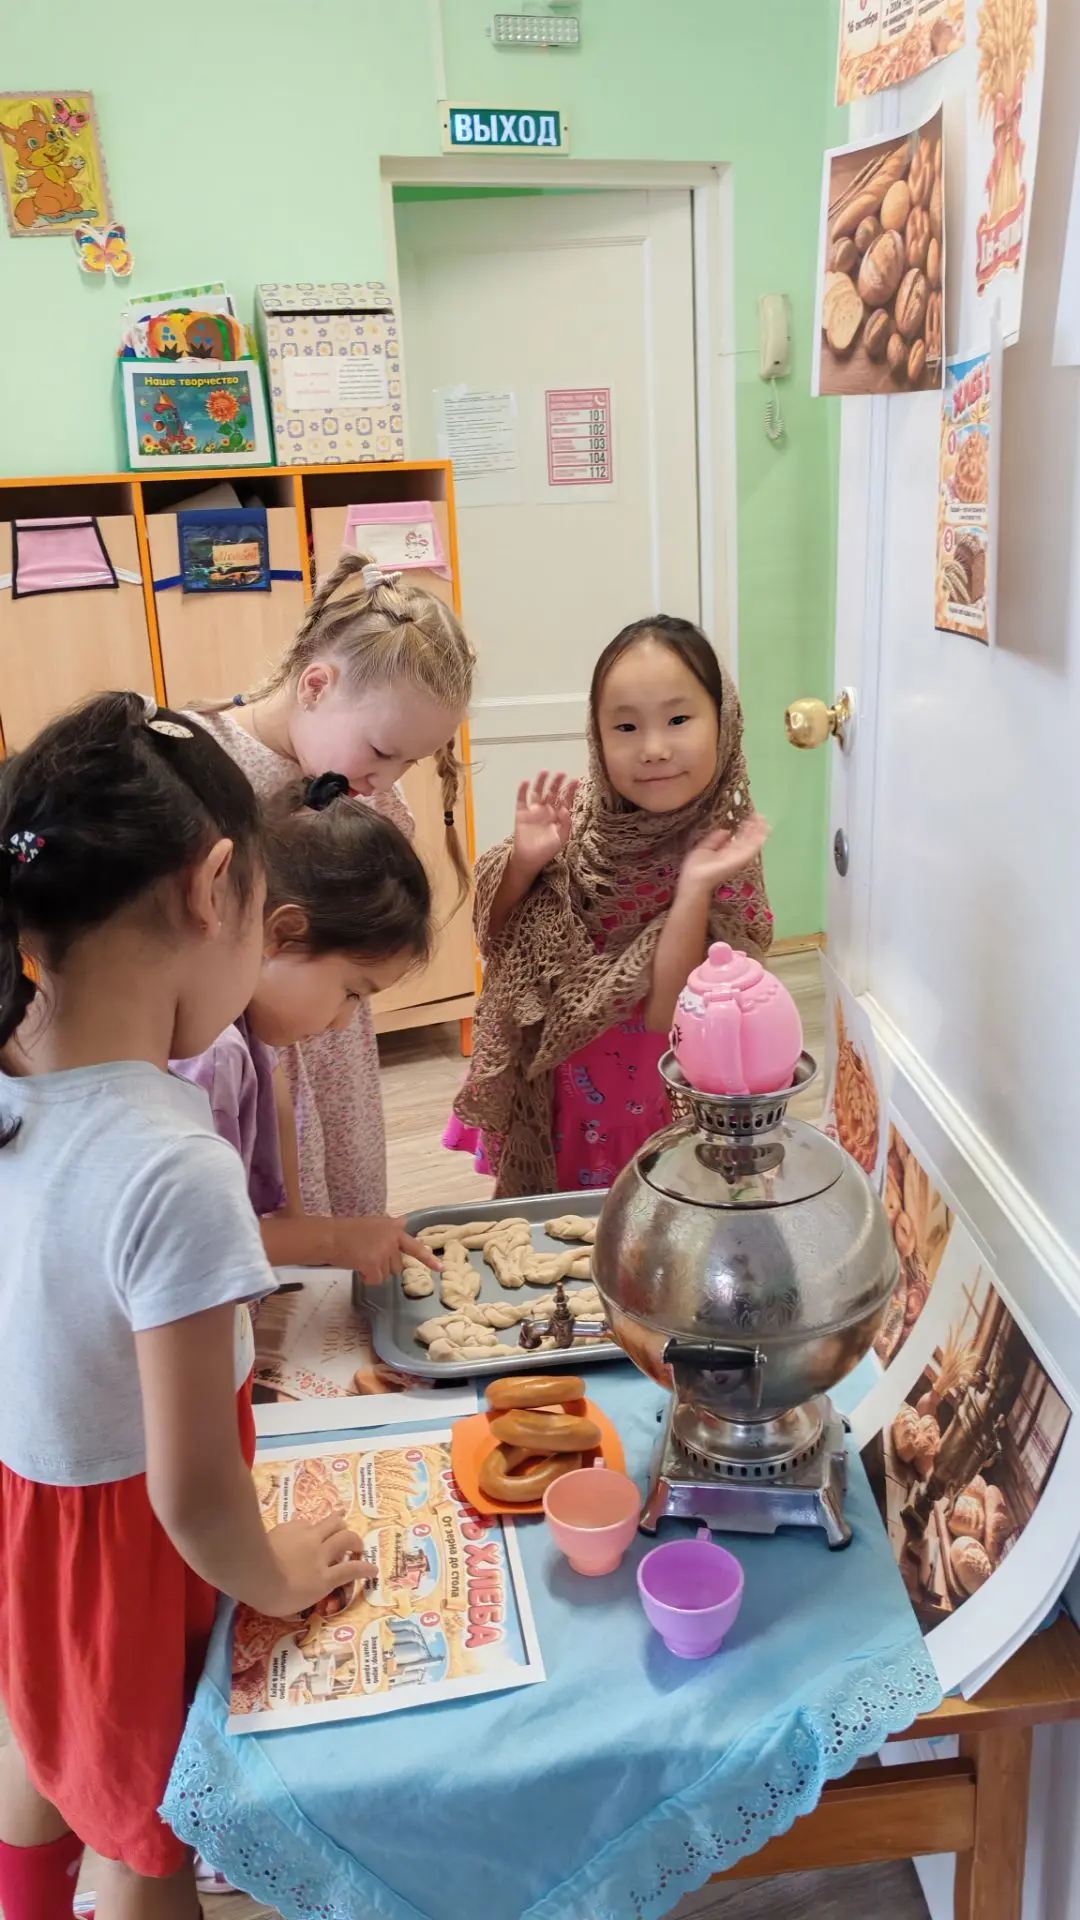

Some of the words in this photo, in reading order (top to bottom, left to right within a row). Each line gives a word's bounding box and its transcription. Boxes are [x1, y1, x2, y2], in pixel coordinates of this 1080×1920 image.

[454, 113, 557, 146] ВЫХОД
[144, 376, 176, 386] Наше
[178, 376, 239, 388] творчество
[589, 410, 604, 421] 101
[589, 424, 605, 435] 102
[589, 438, 605, 450] 103
[590, 452, 605, 463] 104
[590, 466, 606, 477] 112
[442, 1515, 452, 1527] От
[445, 1529, 457, 1555] зерна
[448, 1556, 459, 1570] до
[450, 1571, 460, 1598] стола
[463, 1542, 502, 1648] ХЛЕБА
